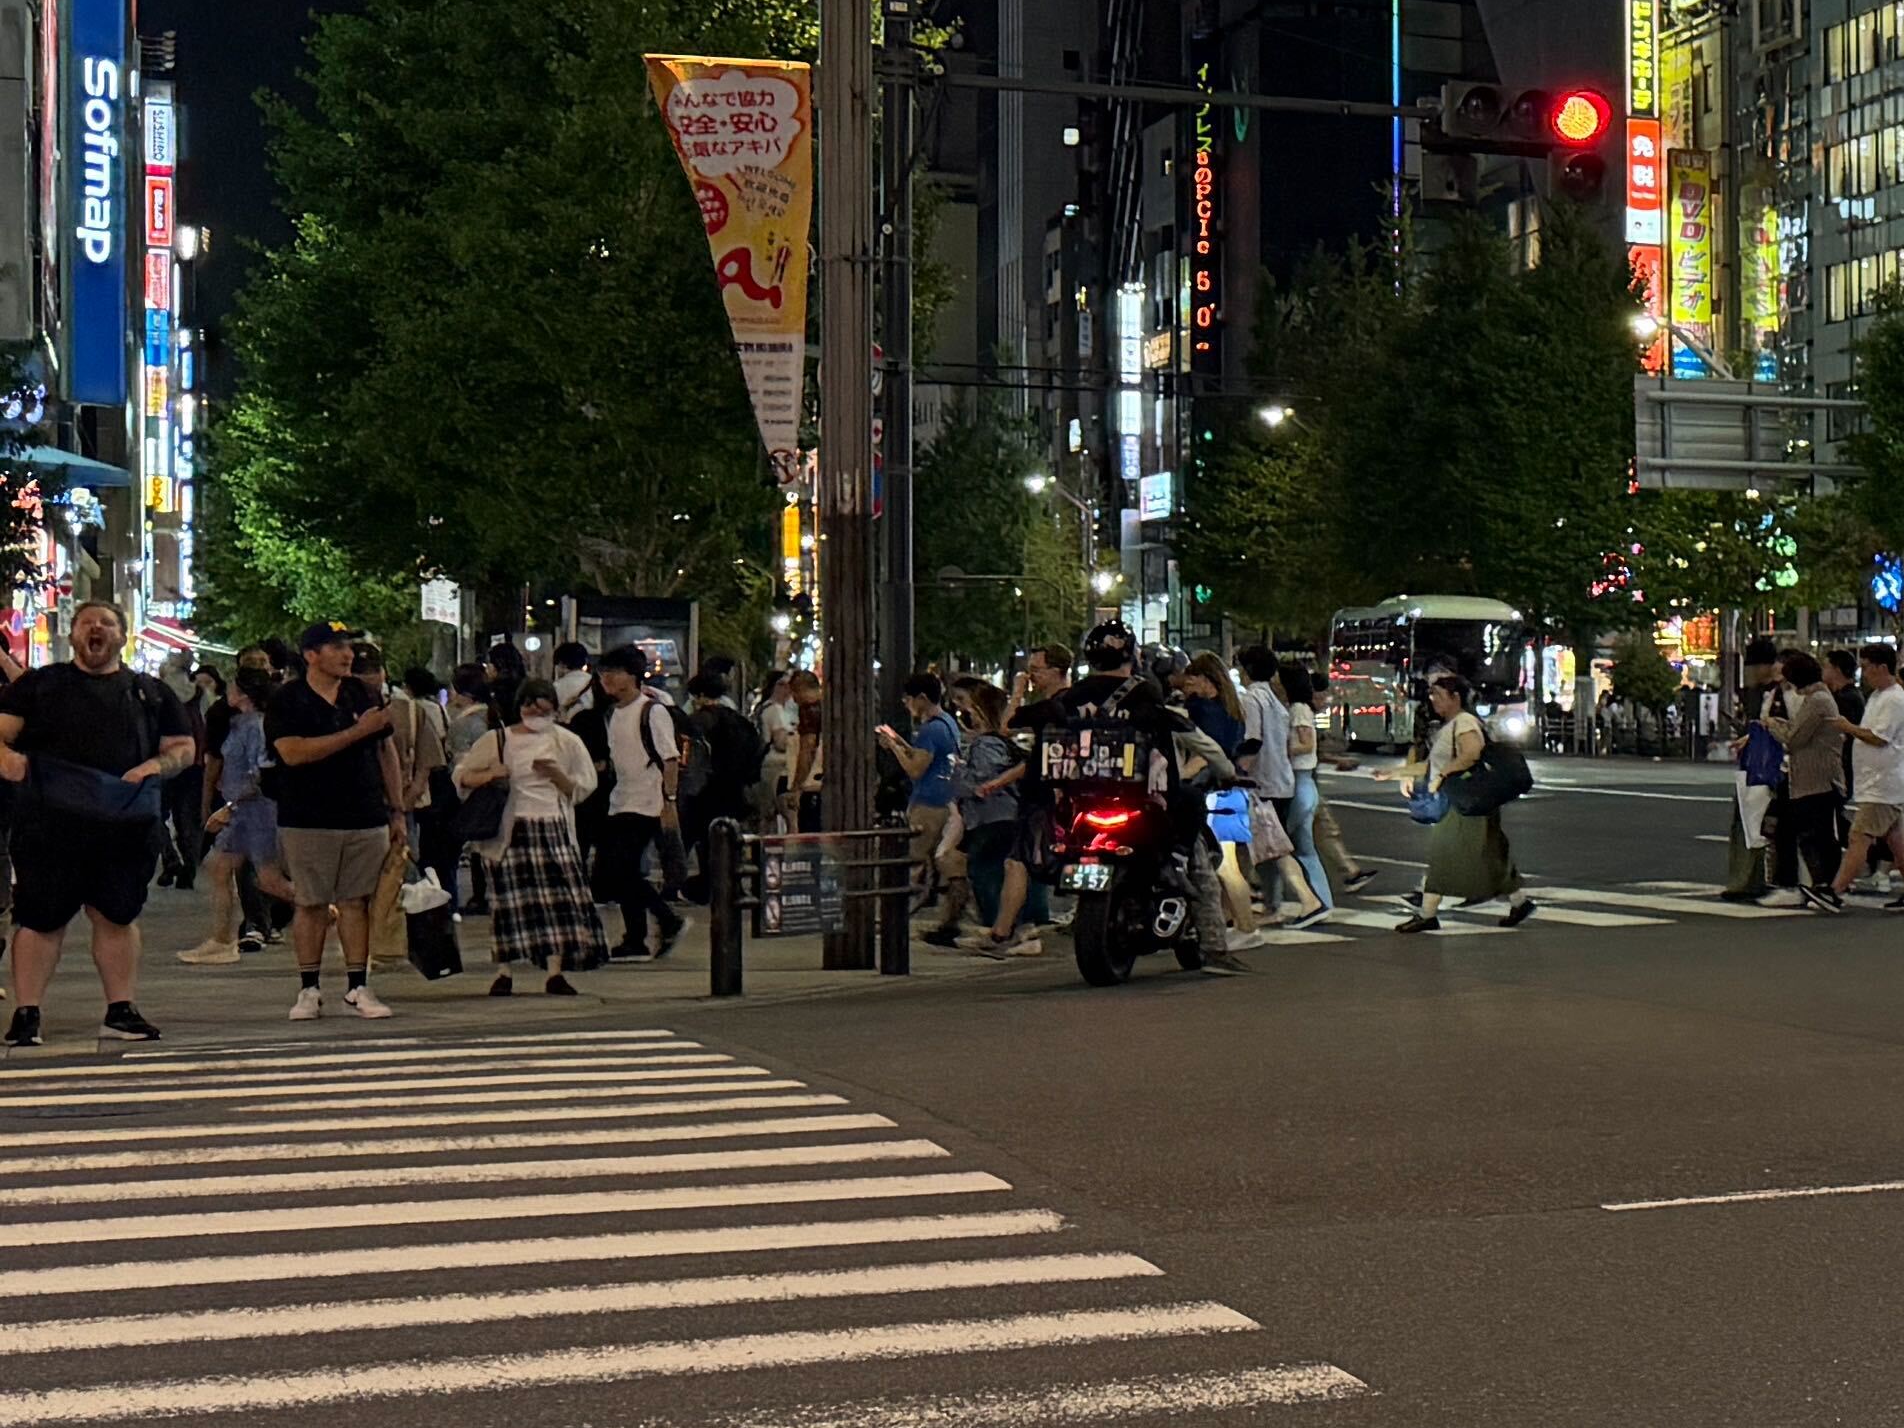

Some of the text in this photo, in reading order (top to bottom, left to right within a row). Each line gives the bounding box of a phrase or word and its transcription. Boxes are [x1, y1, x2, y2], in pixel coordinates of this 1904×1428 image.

[83, 55, 118, 264] Sofmap
[686, 137, 781, 158] 気なアキバ
